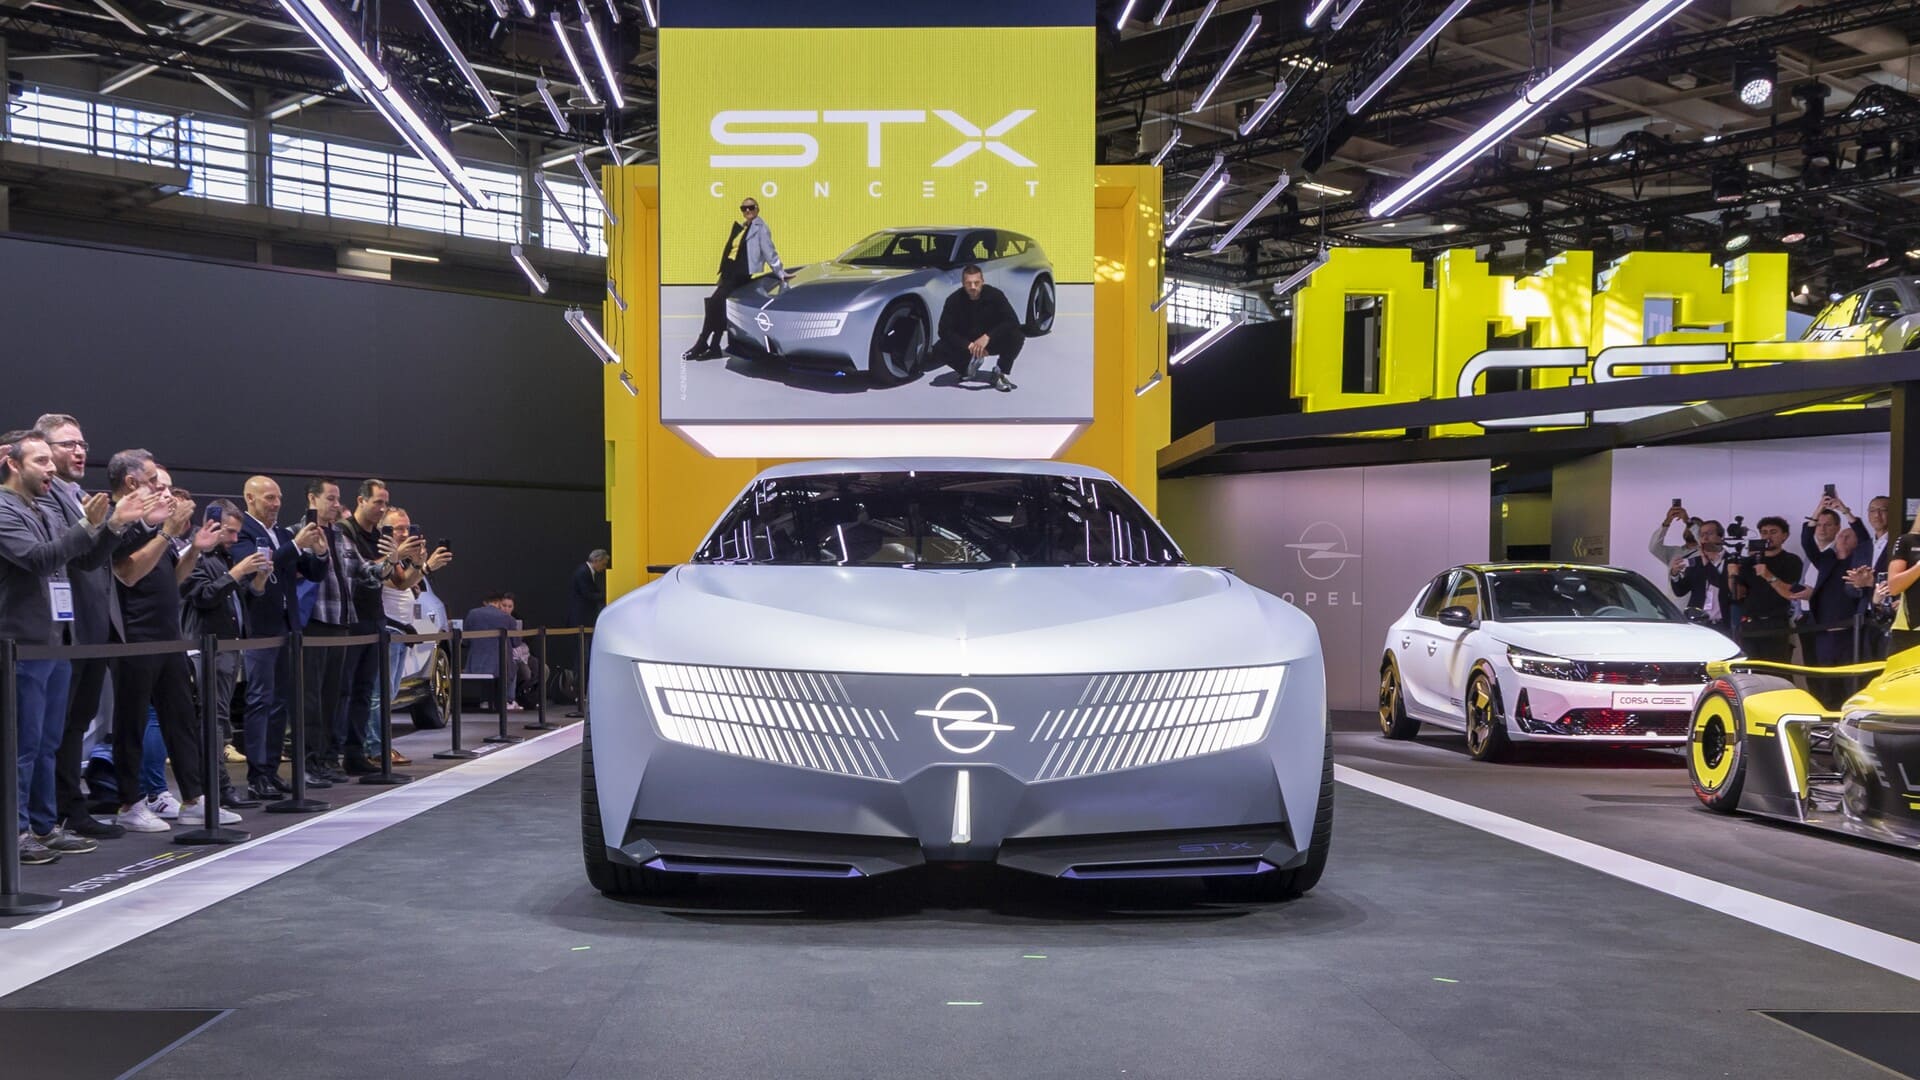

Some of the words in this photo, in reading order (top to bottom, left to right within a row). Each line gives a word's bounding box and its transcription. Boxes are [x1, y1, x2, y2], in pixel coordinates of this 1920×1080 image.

[709, 109, 1039, 168] STX
[709, 181, 1039, 198] CONCEPT
[1281, 591, 1362, 606] OPEL
[1619, 697, 1649, 705] CORSA
[1651, 697, 1687, 705] GSE
[1178, 842, 1253, 854] STX
